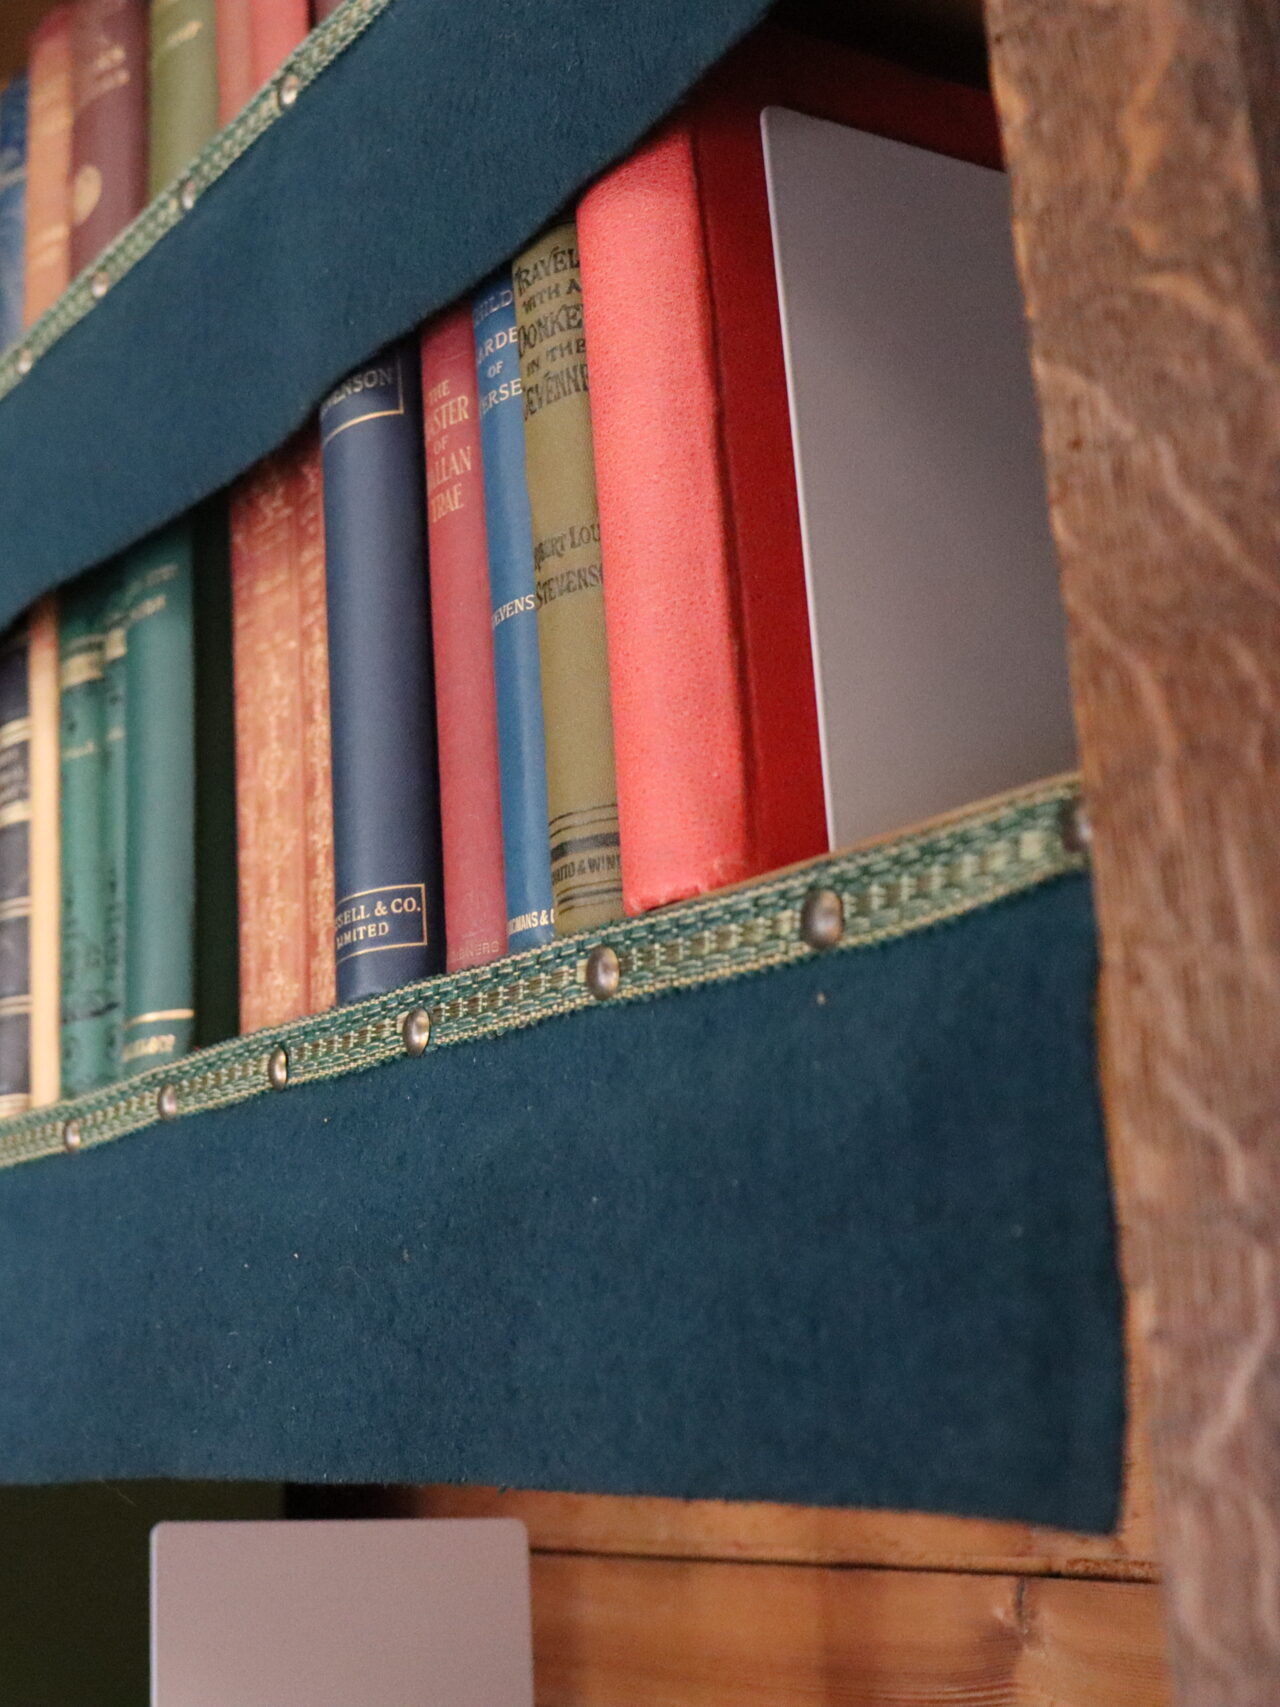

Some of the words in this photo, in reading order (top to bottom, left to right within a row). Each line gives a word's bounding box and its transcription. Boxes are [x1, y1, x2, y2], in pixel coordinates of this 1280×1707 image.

[487, 361, 504, 378] OF
[374, 901, 388, 917] &
[390, 897, 421, 913] CO.
[336, 921, 389, 949] LIMITED
